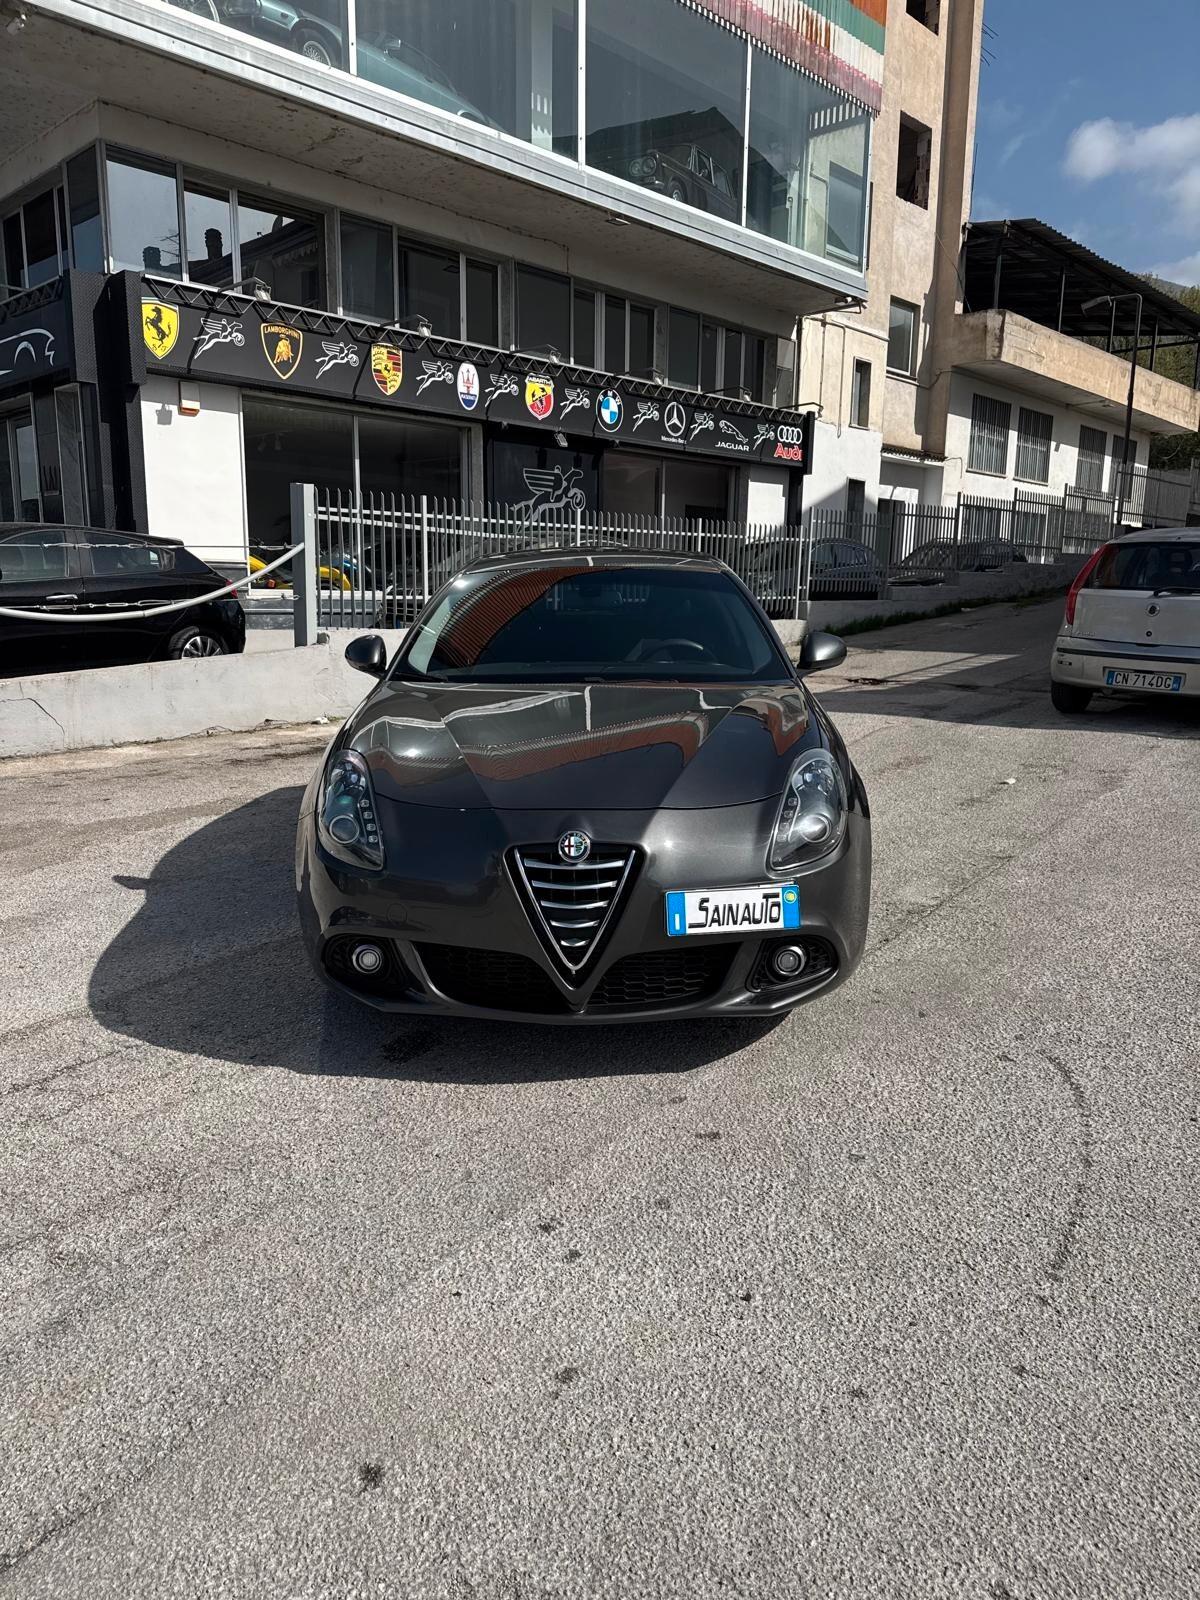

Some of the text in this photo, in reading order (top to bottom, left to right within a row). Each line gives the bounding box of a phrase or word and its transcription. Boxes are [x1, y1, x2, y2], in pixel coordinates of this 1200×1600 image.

[264, 326, 300, 339] LAMBORGHINI
[527, 376, 552, 386] ABARTH
[715, 441, 750, 452] JAGUAR
[774, 442, 803, 461] Audi
[1114, 672, 1129, 685] CN
[687, 892, 781, 929] SAINAUTO
